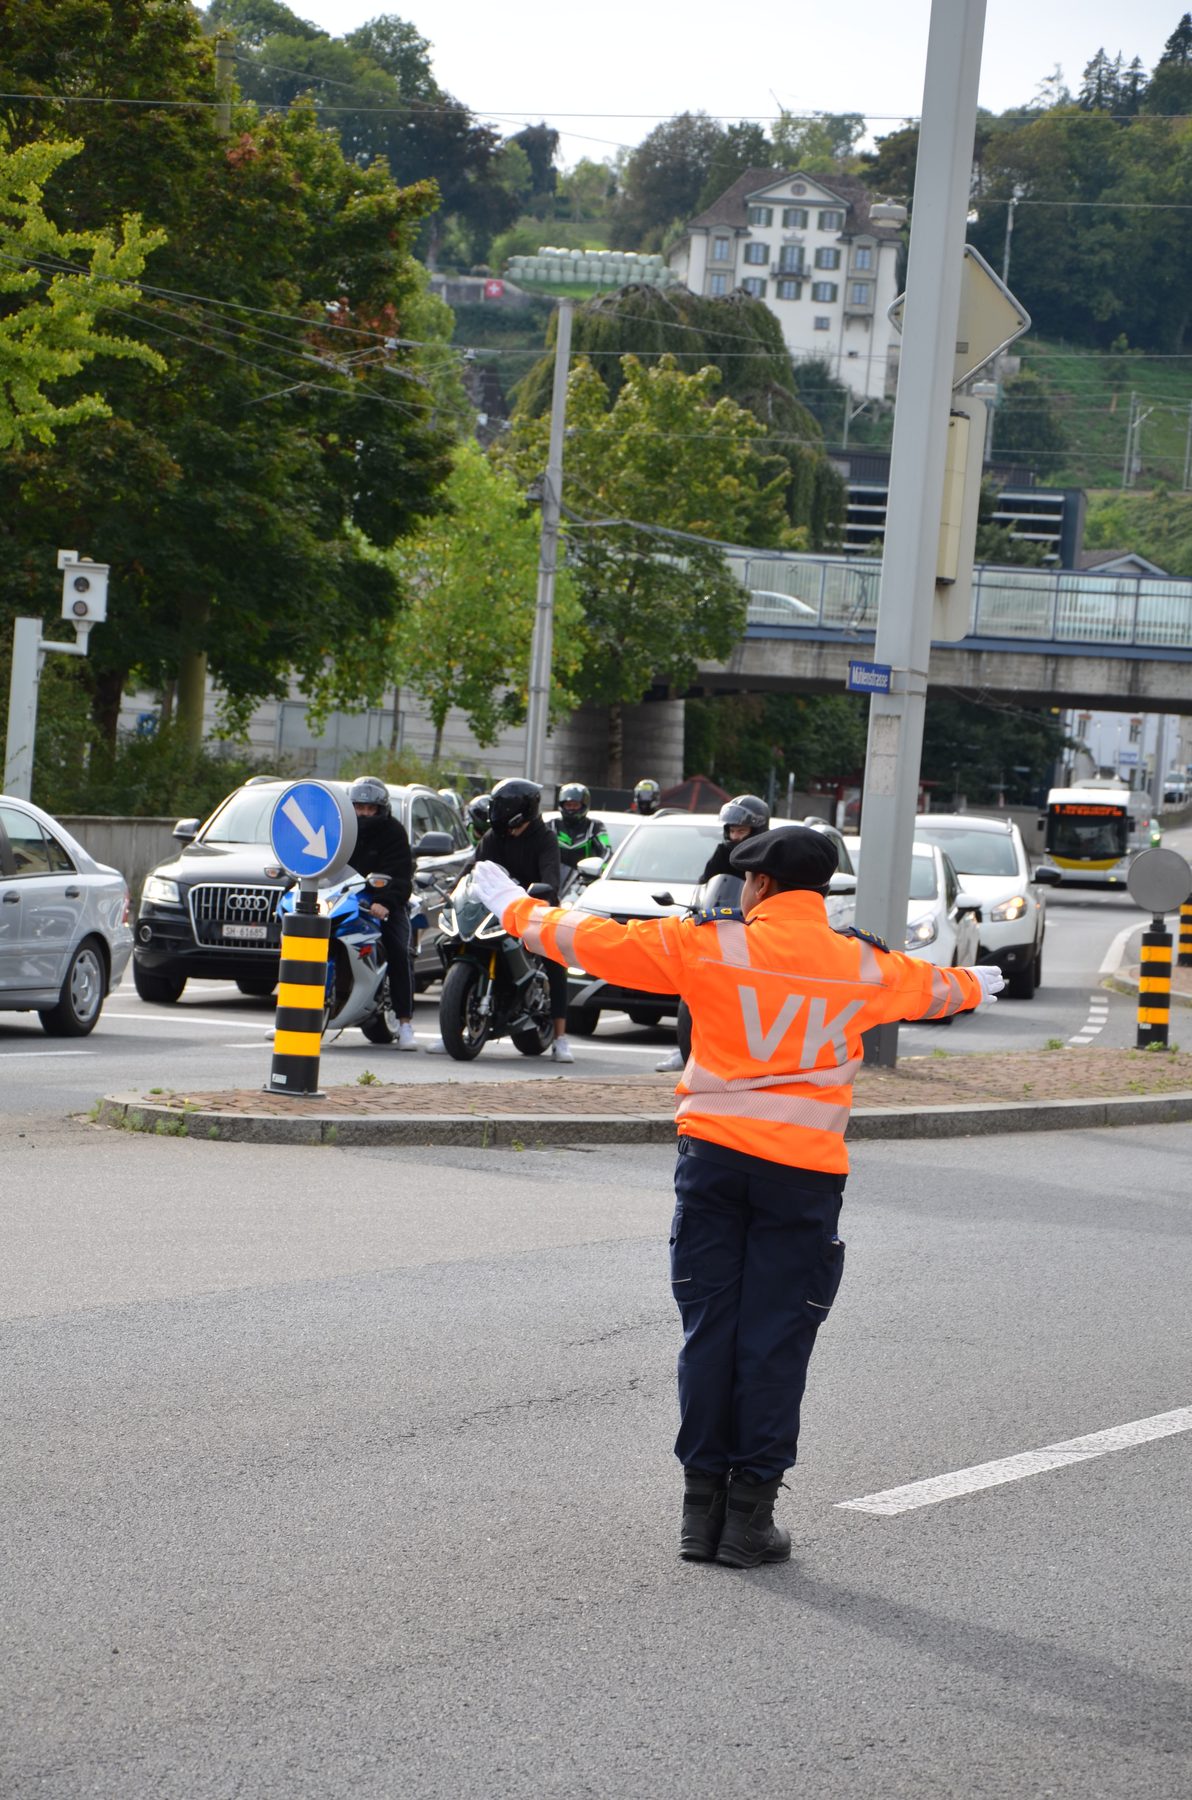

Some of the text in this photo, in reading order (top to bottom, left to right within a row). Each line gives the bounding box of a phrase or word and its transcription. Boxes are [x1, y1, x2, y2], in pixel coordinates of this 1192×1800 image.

[852, 666, 888, 688] Mühlenstrasse
[225, 927, 235, 936] SH
[737, 984, 866, 1069] VK
